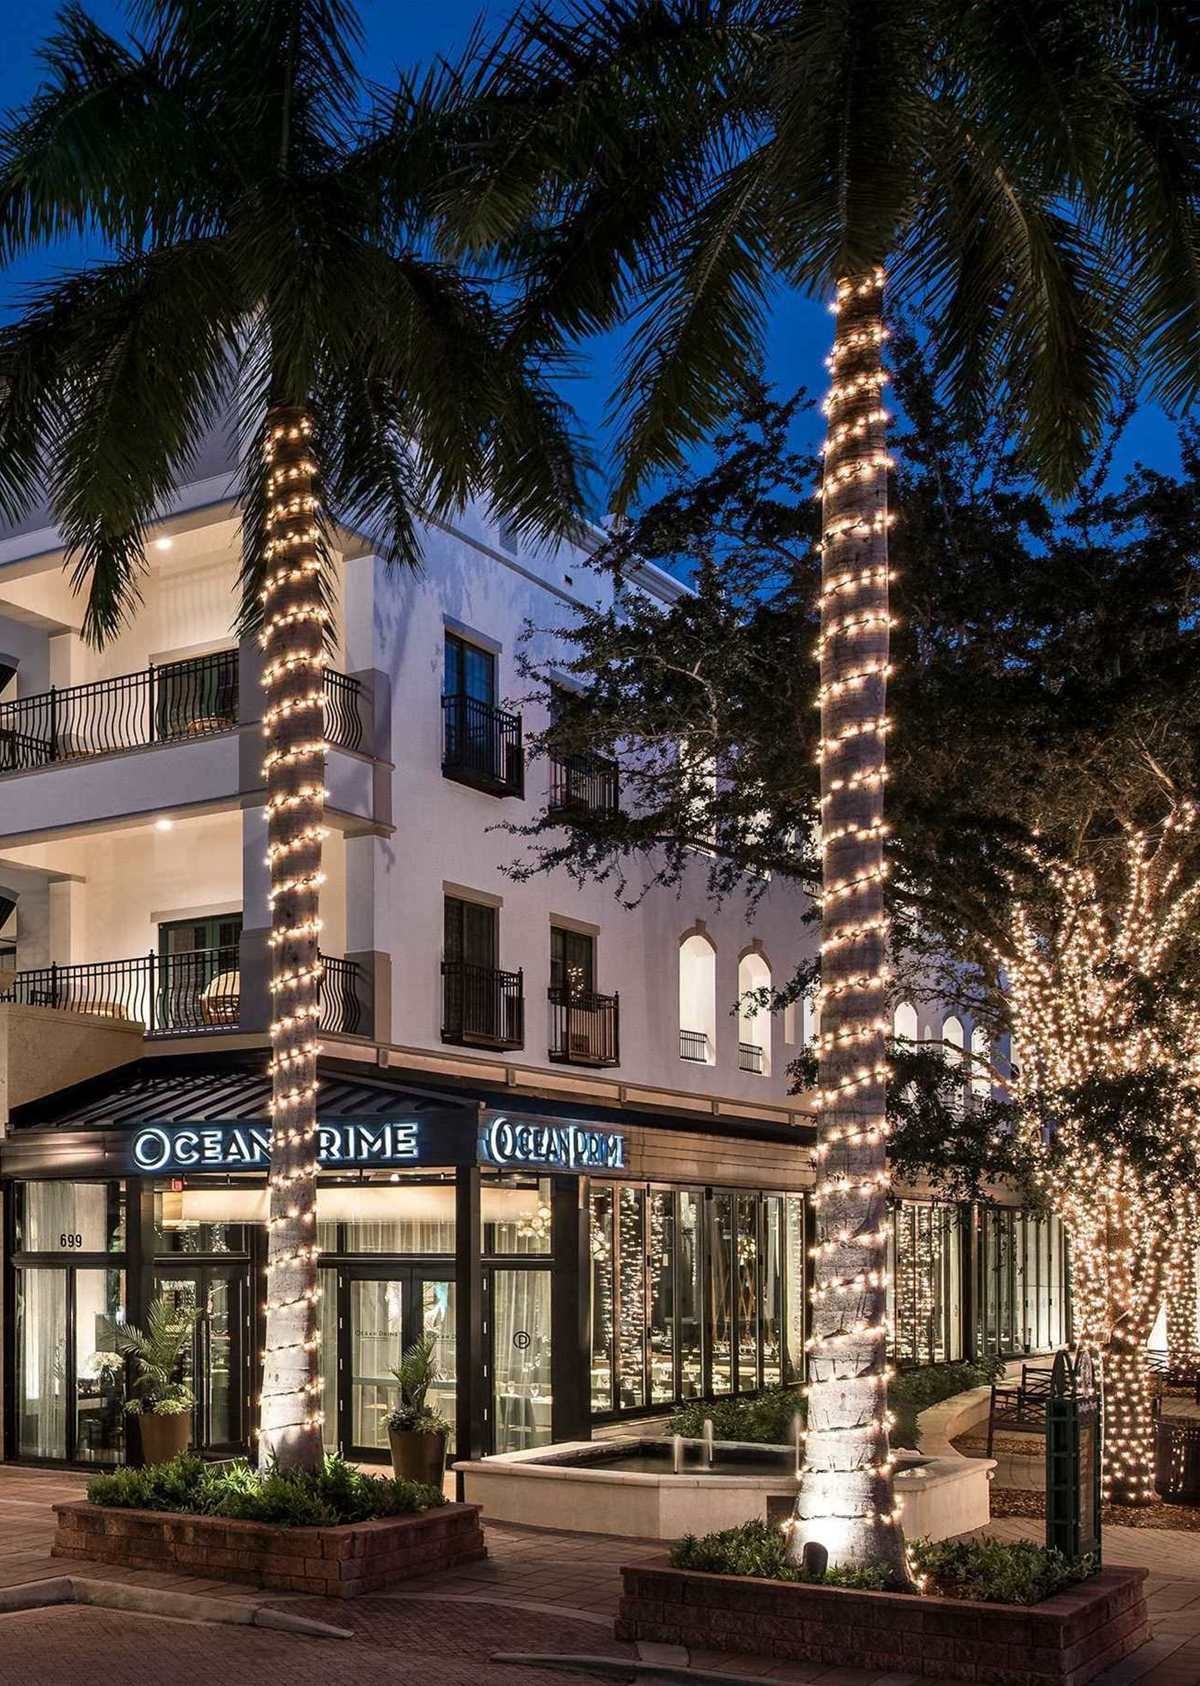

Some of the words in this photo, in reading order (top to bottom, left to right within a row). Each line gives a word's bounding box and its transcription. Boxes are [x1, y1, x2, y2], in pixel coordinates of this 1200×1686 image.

[134, 1127, 272, 1171] OCEAN
[316, 1122, 419, 1161] RIME
[60, 1234, 82, 1248] 699
